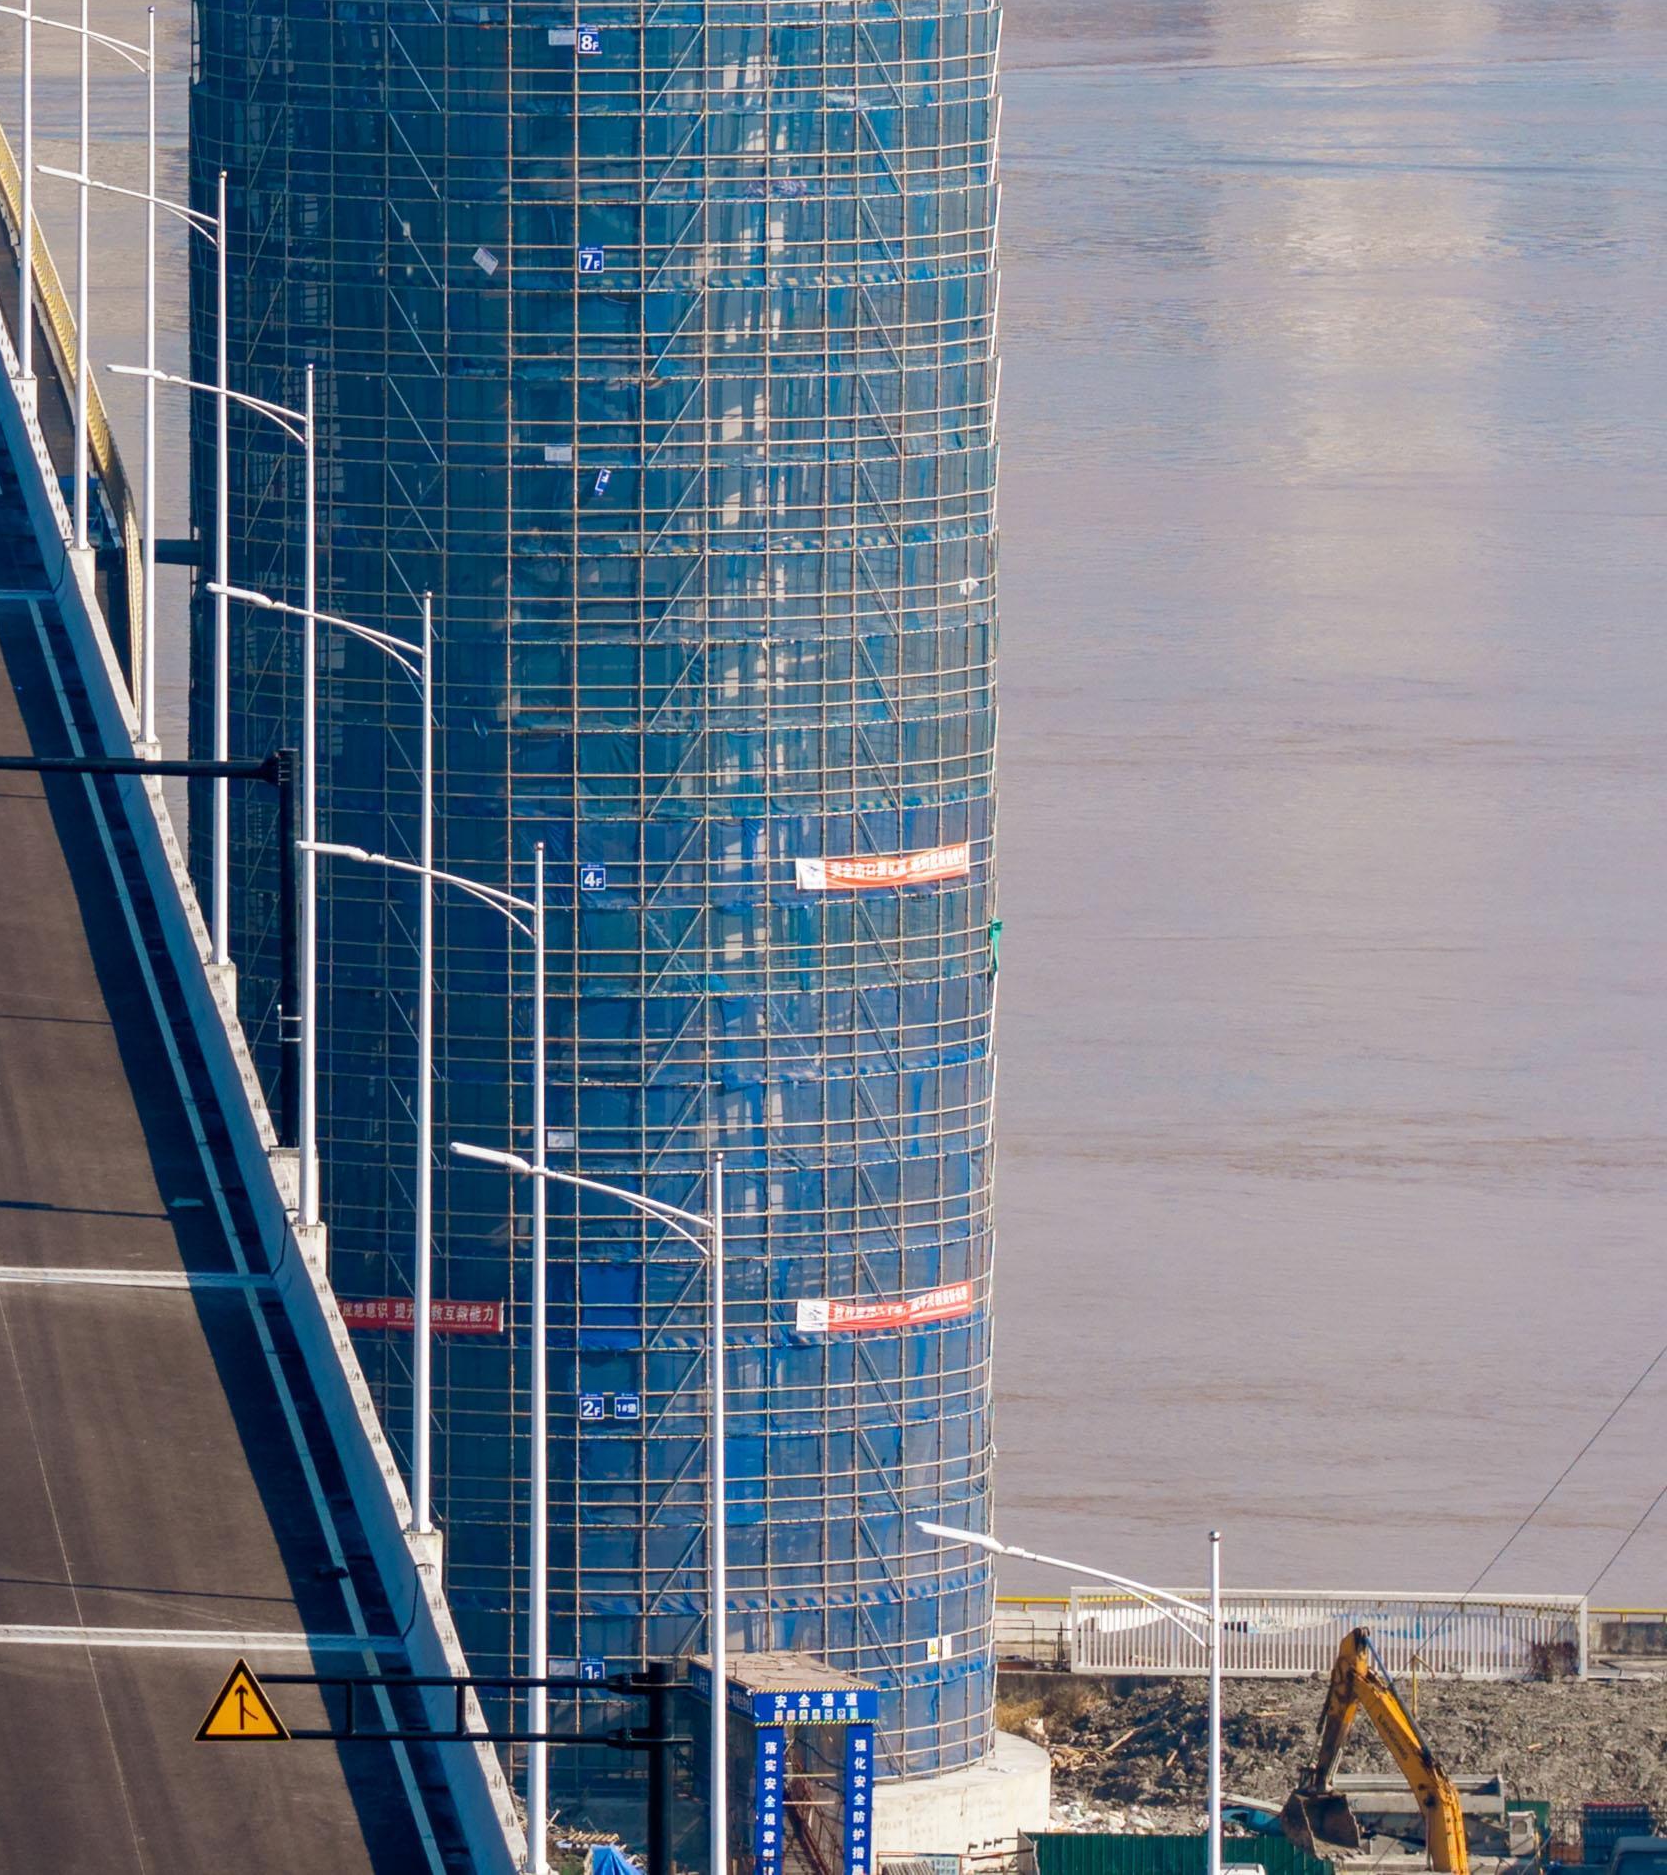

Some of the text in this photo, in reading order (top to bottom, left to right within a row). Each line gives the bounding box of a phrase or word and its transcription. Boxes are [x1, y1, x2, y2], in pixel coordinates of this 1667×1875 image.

[581, 34, 600, 51] 8F
[582, 254, 600, 270] 7F
[584, 871, 603, 888] 4F
[338, 1300, 494, 1323] 应急意识 提升救互救能力
[582, 1400, 601, 1417] 2F
[584, 1664, 601, 1679] 1F
[774, 1693, 859, 1709] 安全通道
